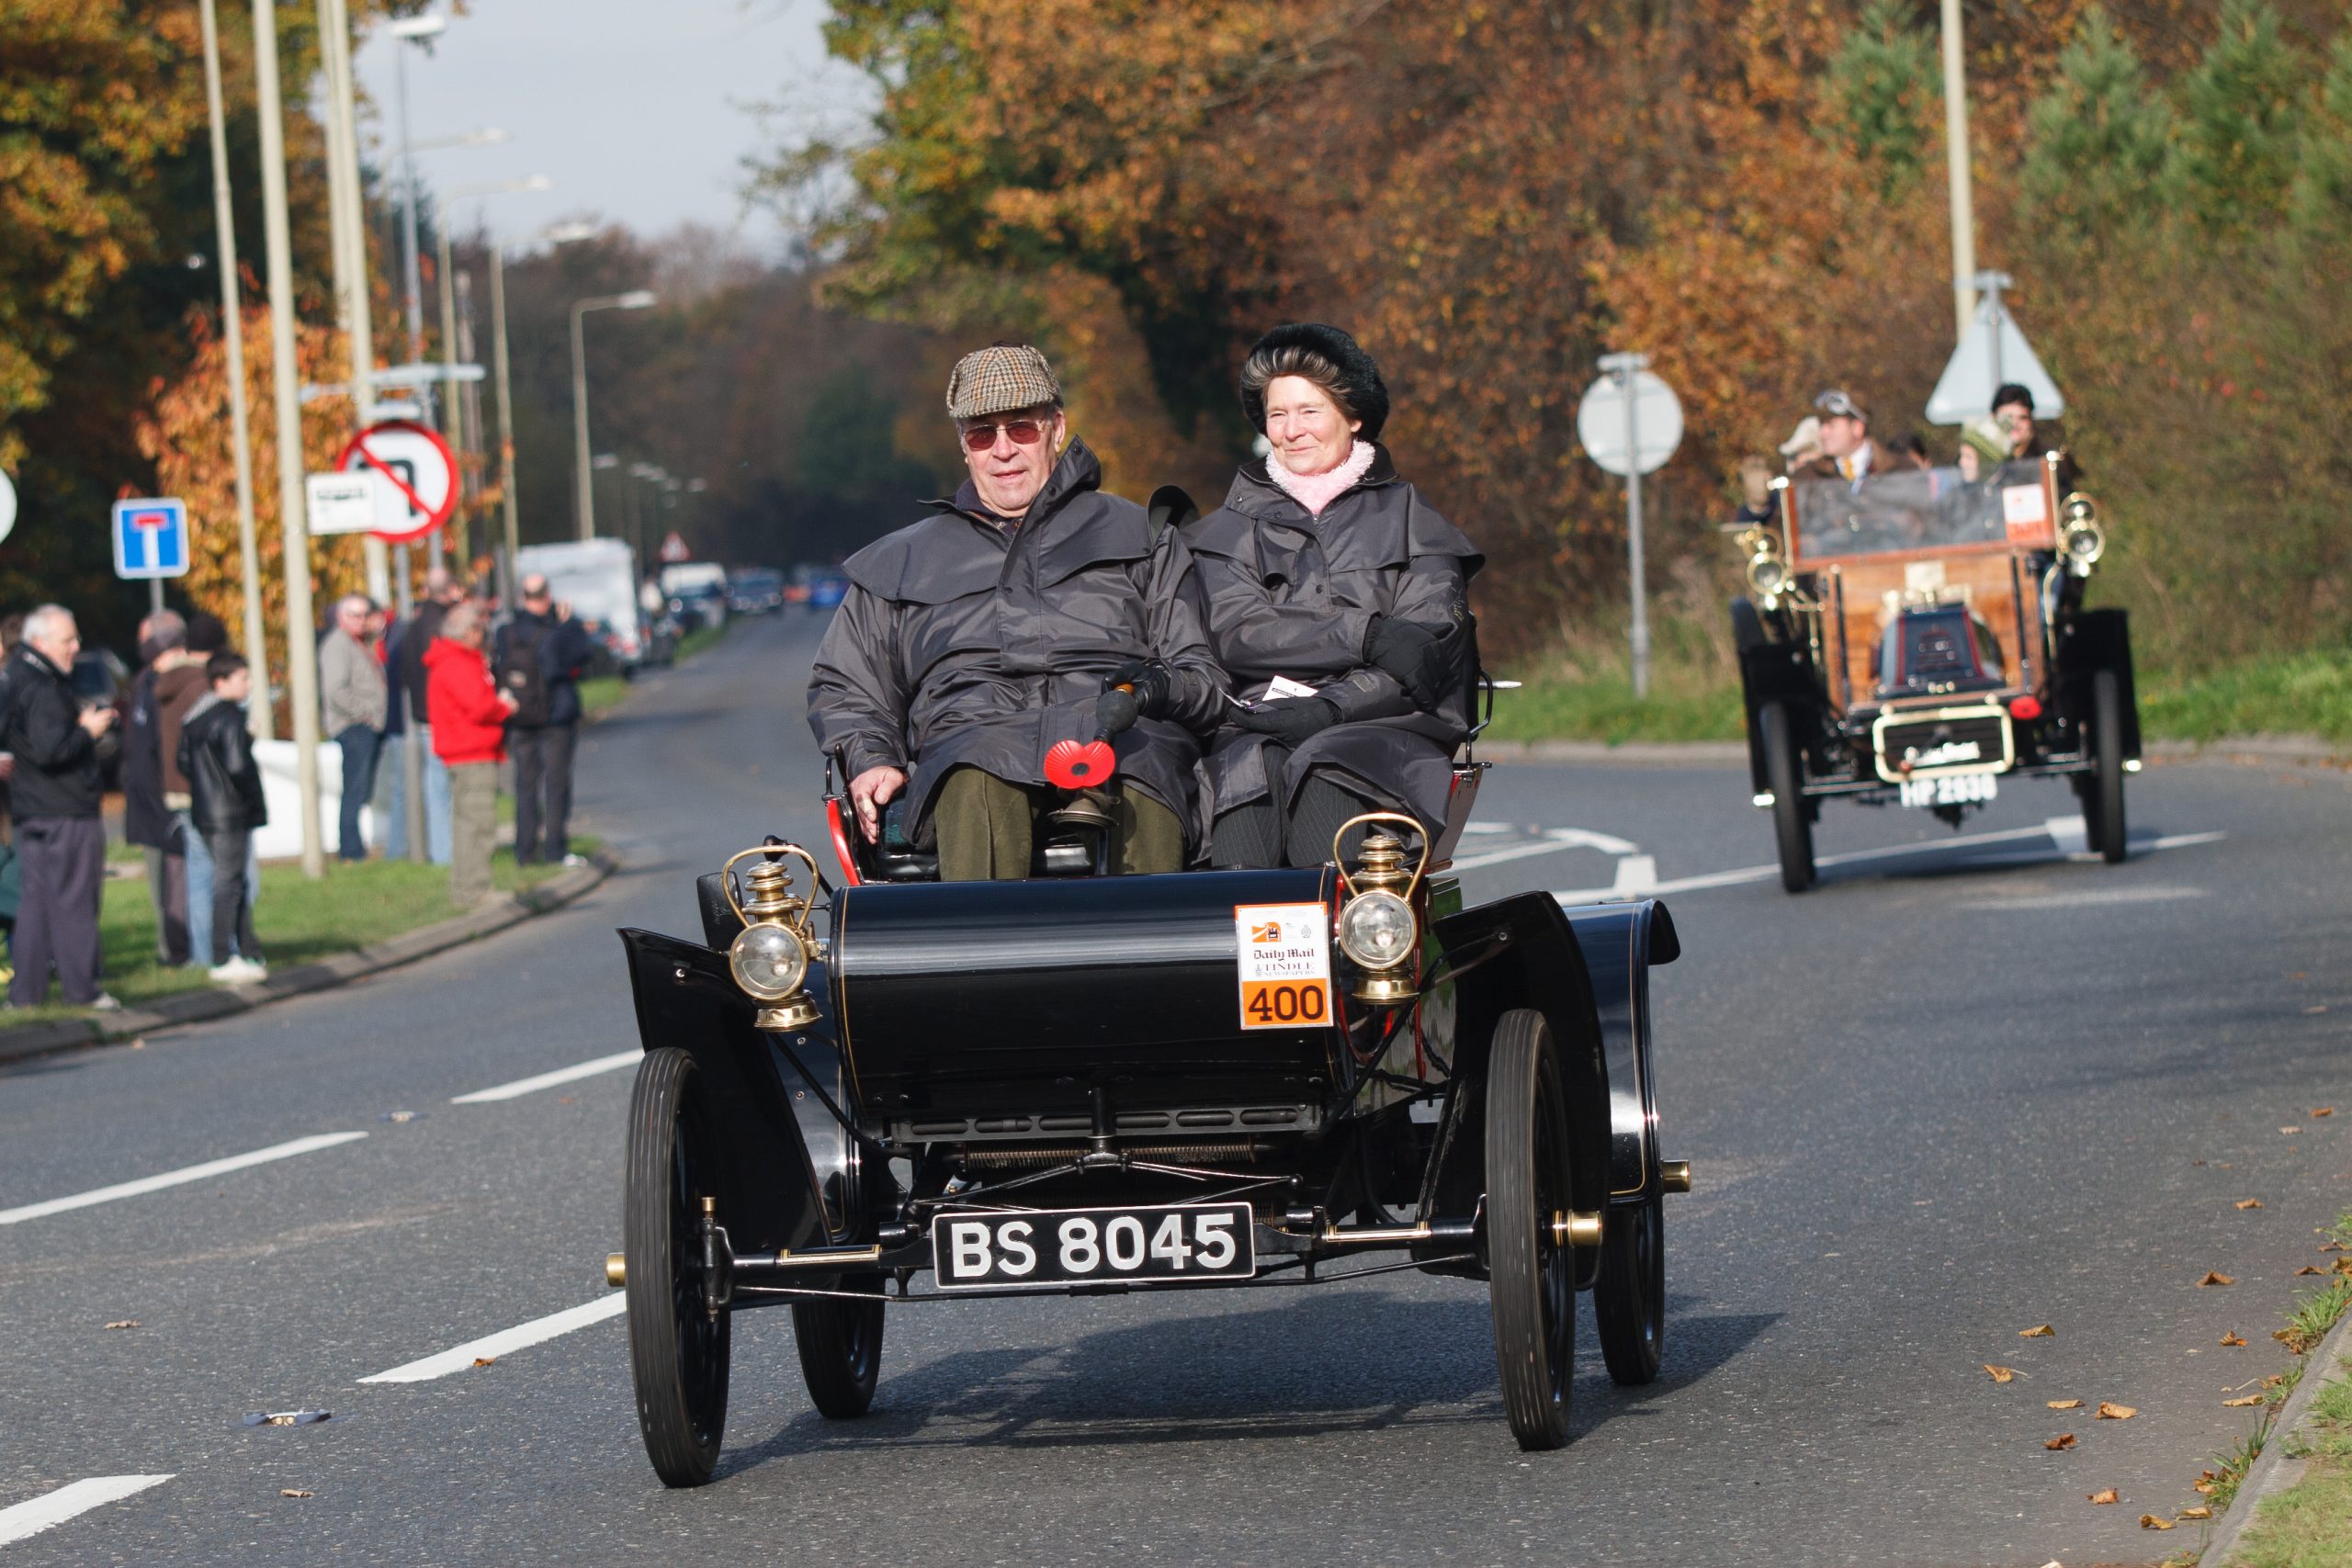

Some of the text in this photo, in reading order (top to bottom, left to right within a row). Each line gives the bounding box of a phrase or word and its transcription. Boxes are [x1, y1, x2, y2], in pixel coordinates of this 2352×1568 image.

[1253, 947, 1315, 962] Daily Mail
[1263, 962, 1315, 972] TINDLE
[1248, 985, 1324, 1021] 400
[951, 1213, 1236, 1278] BS 8045
